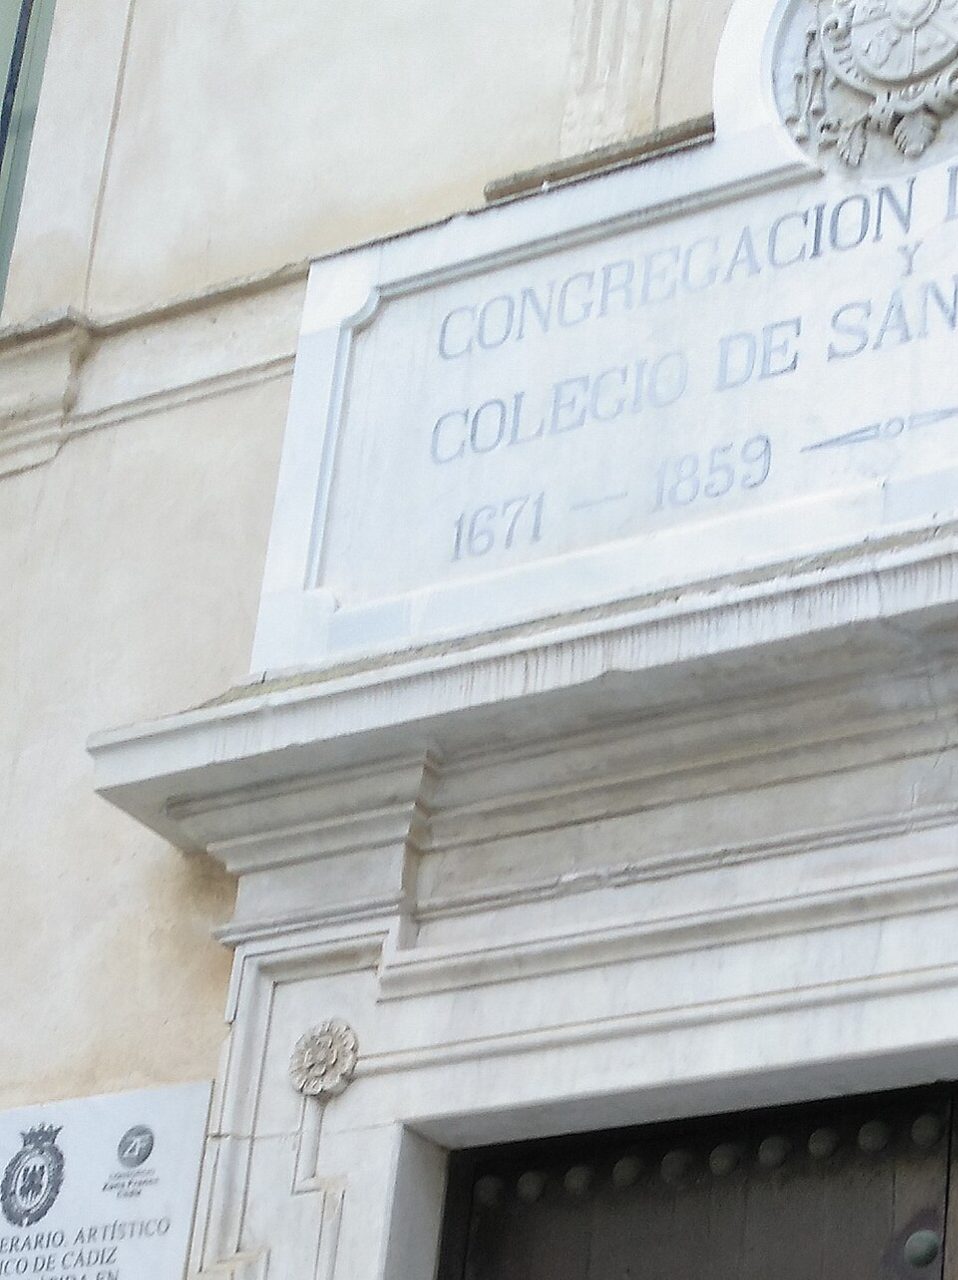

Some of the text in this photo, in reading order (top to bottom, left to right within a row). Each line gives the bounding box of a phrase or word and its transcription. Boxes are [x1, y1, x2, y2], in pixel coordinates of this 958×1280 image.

[900, 239, 924, 277] Y
[430, 350, 688, 465] COLEGIO
[717, 316, 802, 392] DE
[451, 491, 545, 564] 1671
[650, 433, 773, 514] 1859
